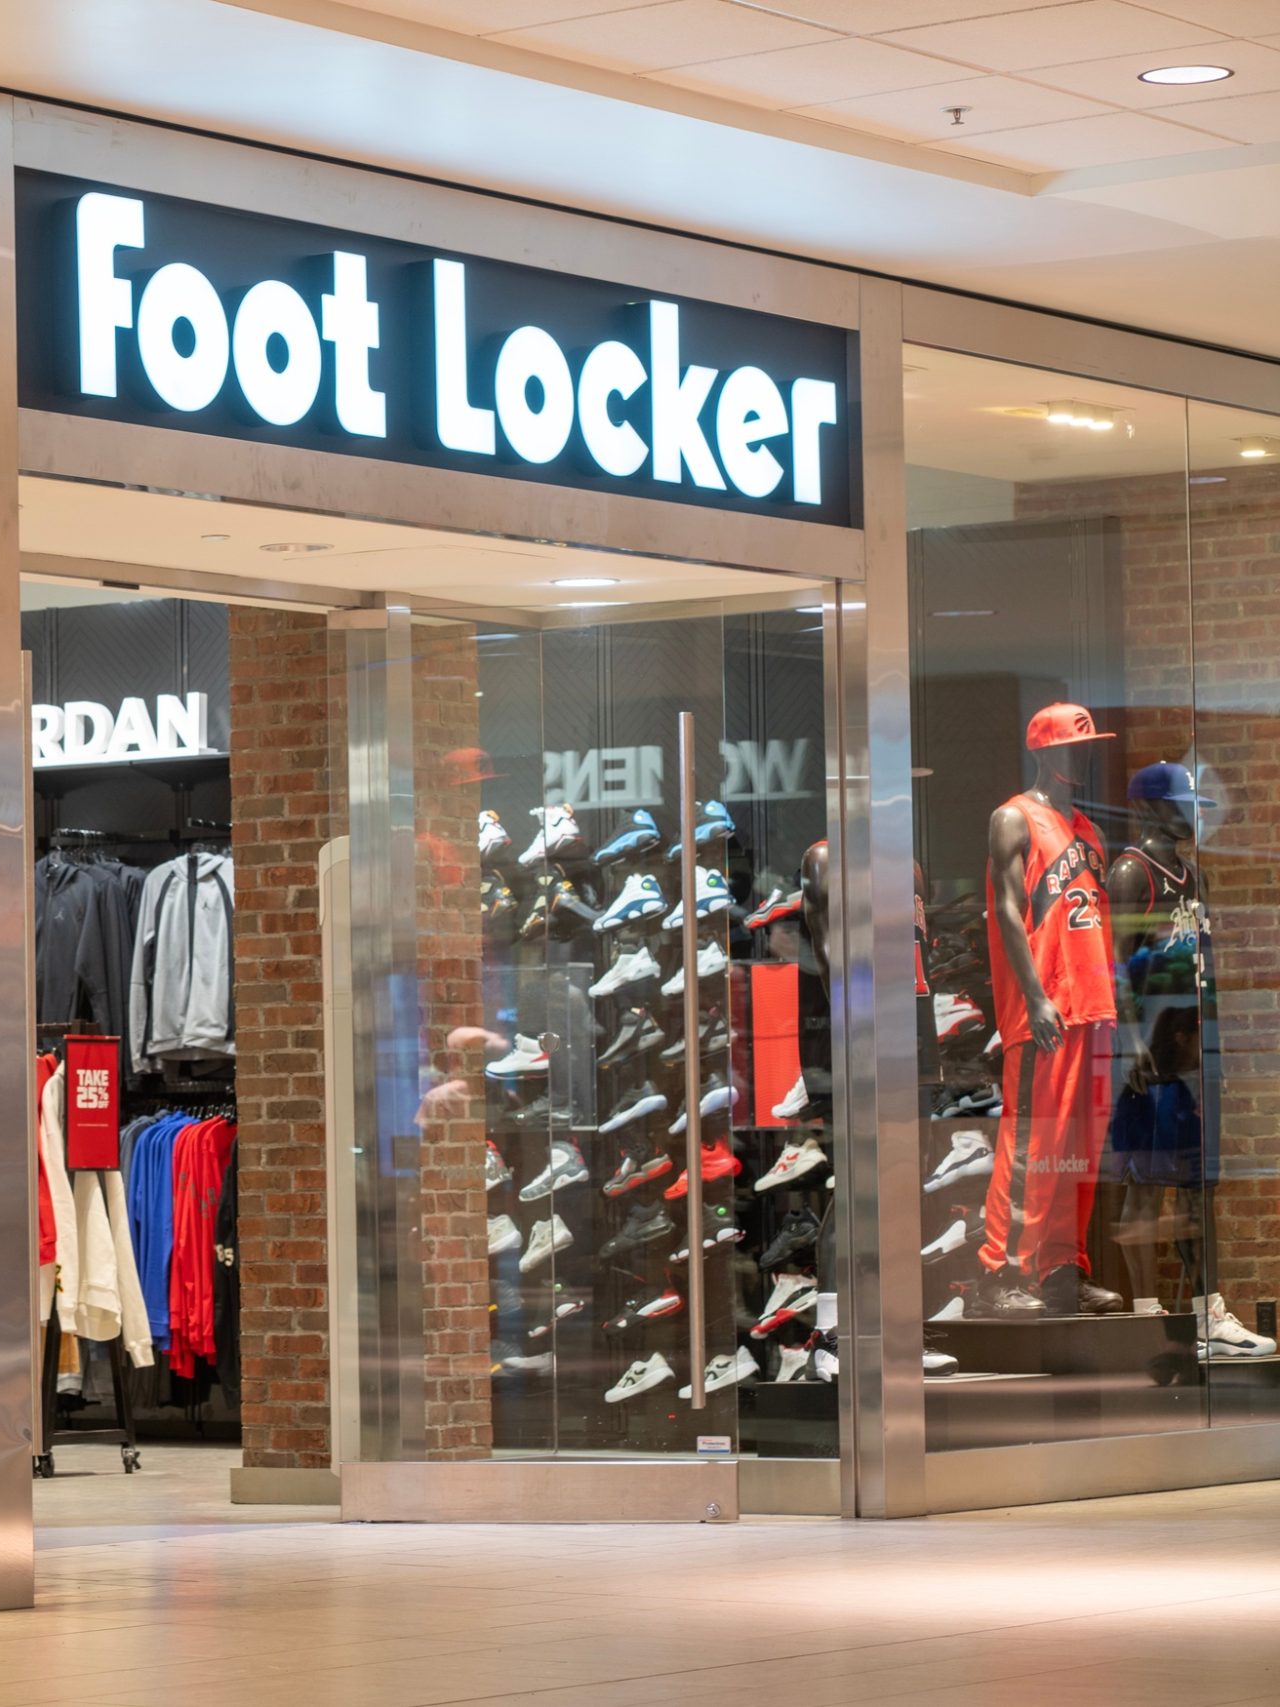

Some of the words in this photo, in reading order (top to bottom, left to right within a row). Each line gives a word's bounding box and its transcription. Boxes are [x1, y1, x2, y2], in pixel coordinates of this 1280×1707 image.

[76, 191, 387, 439] Foot
[433, 257, 838, 506] Locker
[76, 1069, 109, 1086] TAKE
[1053, 1154, 1090, 1173] Locker
